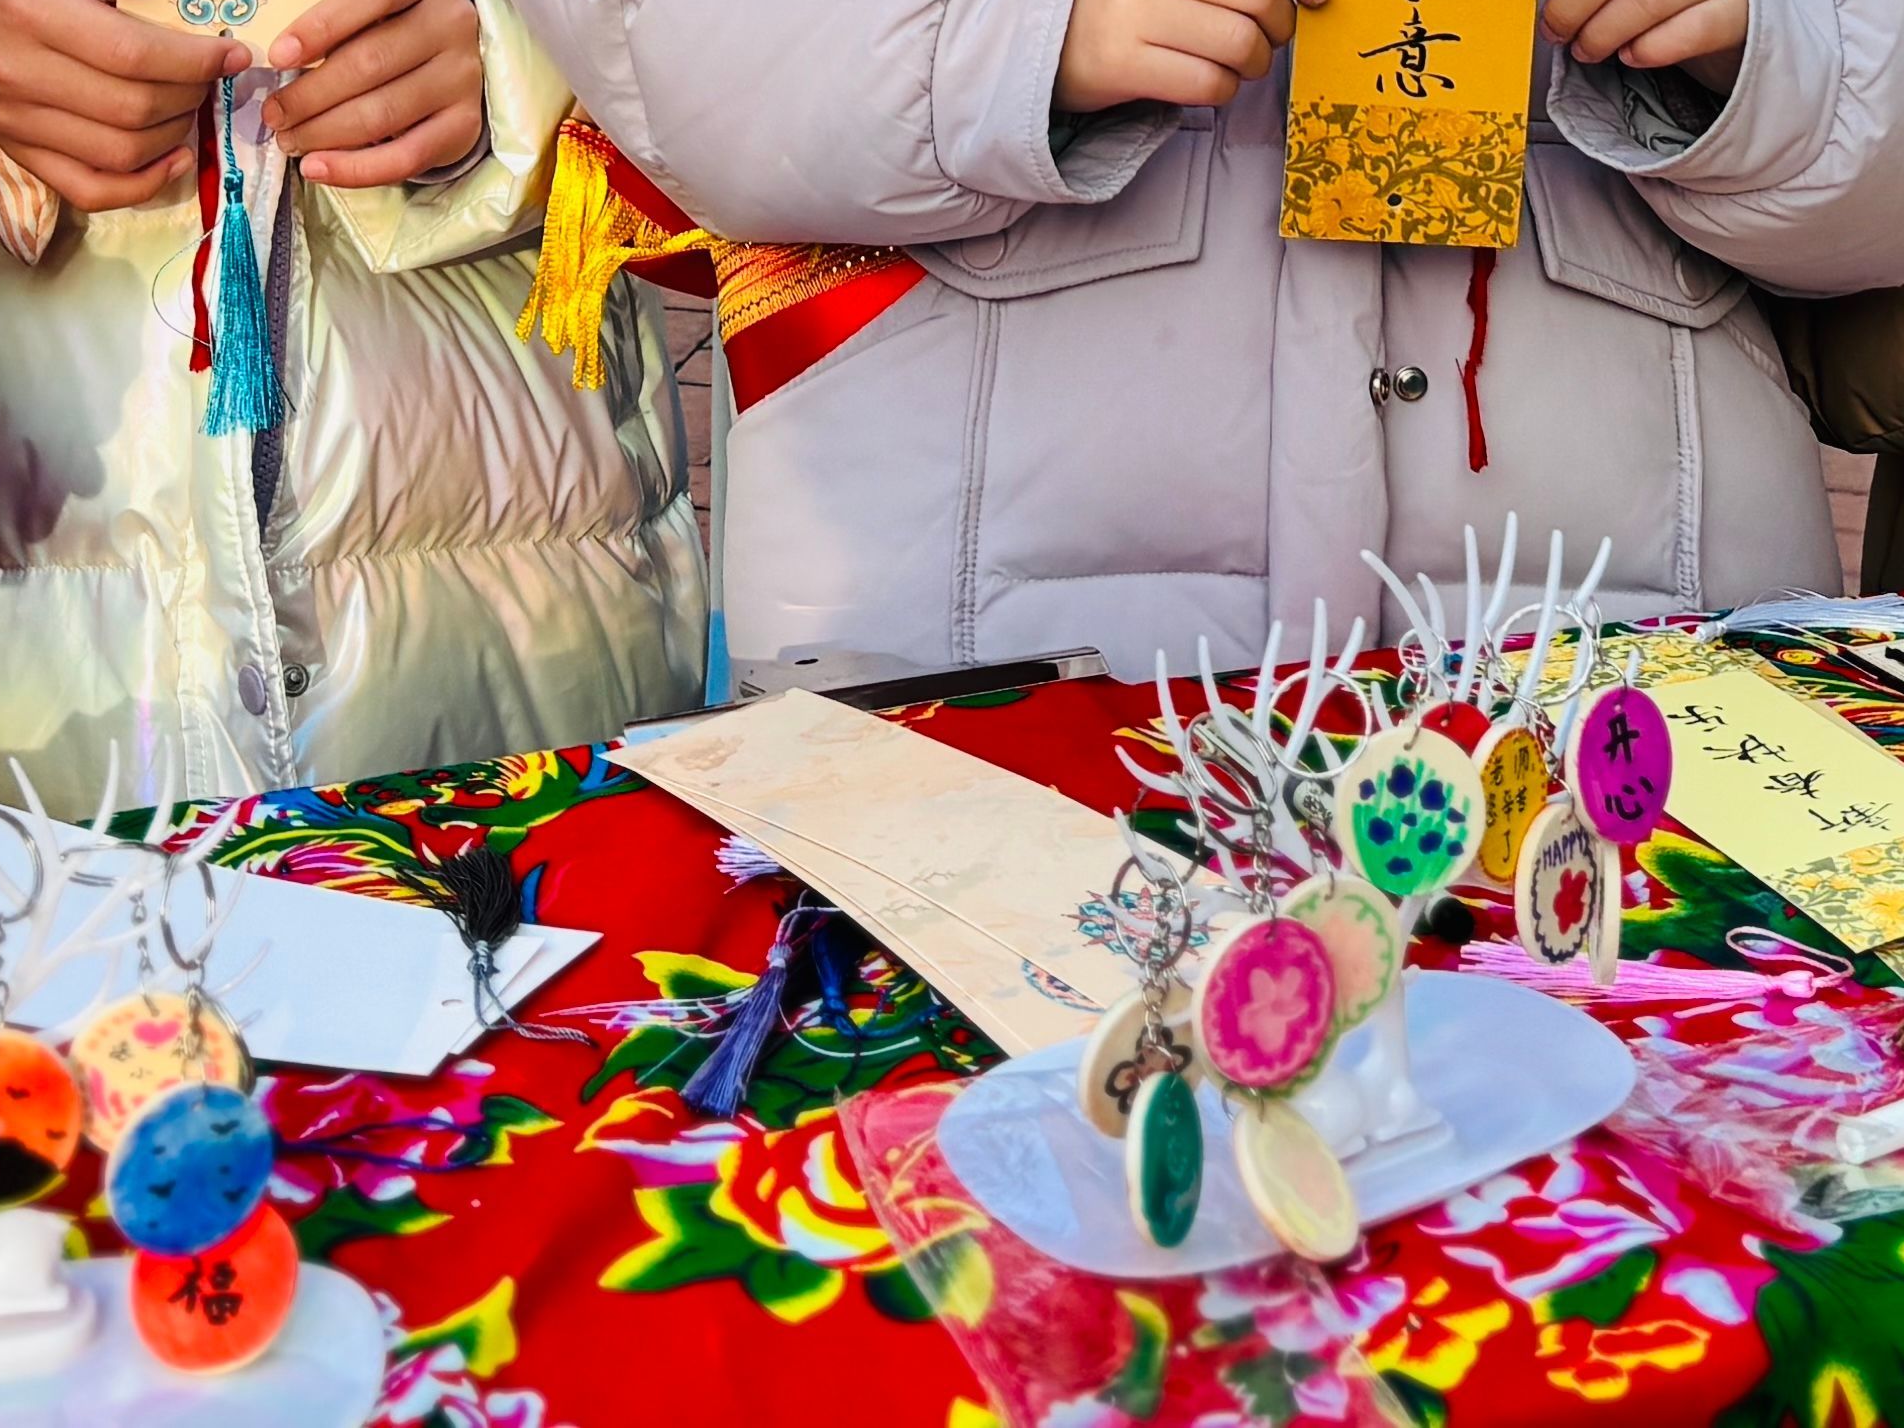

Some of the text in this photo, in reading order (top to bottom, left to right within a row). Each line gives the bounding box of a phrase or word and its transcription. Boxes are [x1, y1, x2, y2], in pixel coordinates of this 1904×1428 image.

[1604, 712, 1654, 821] 开心
[1543, 825, 1590, 869] HAPPY
[168, 1254, 243, 1326] 福
